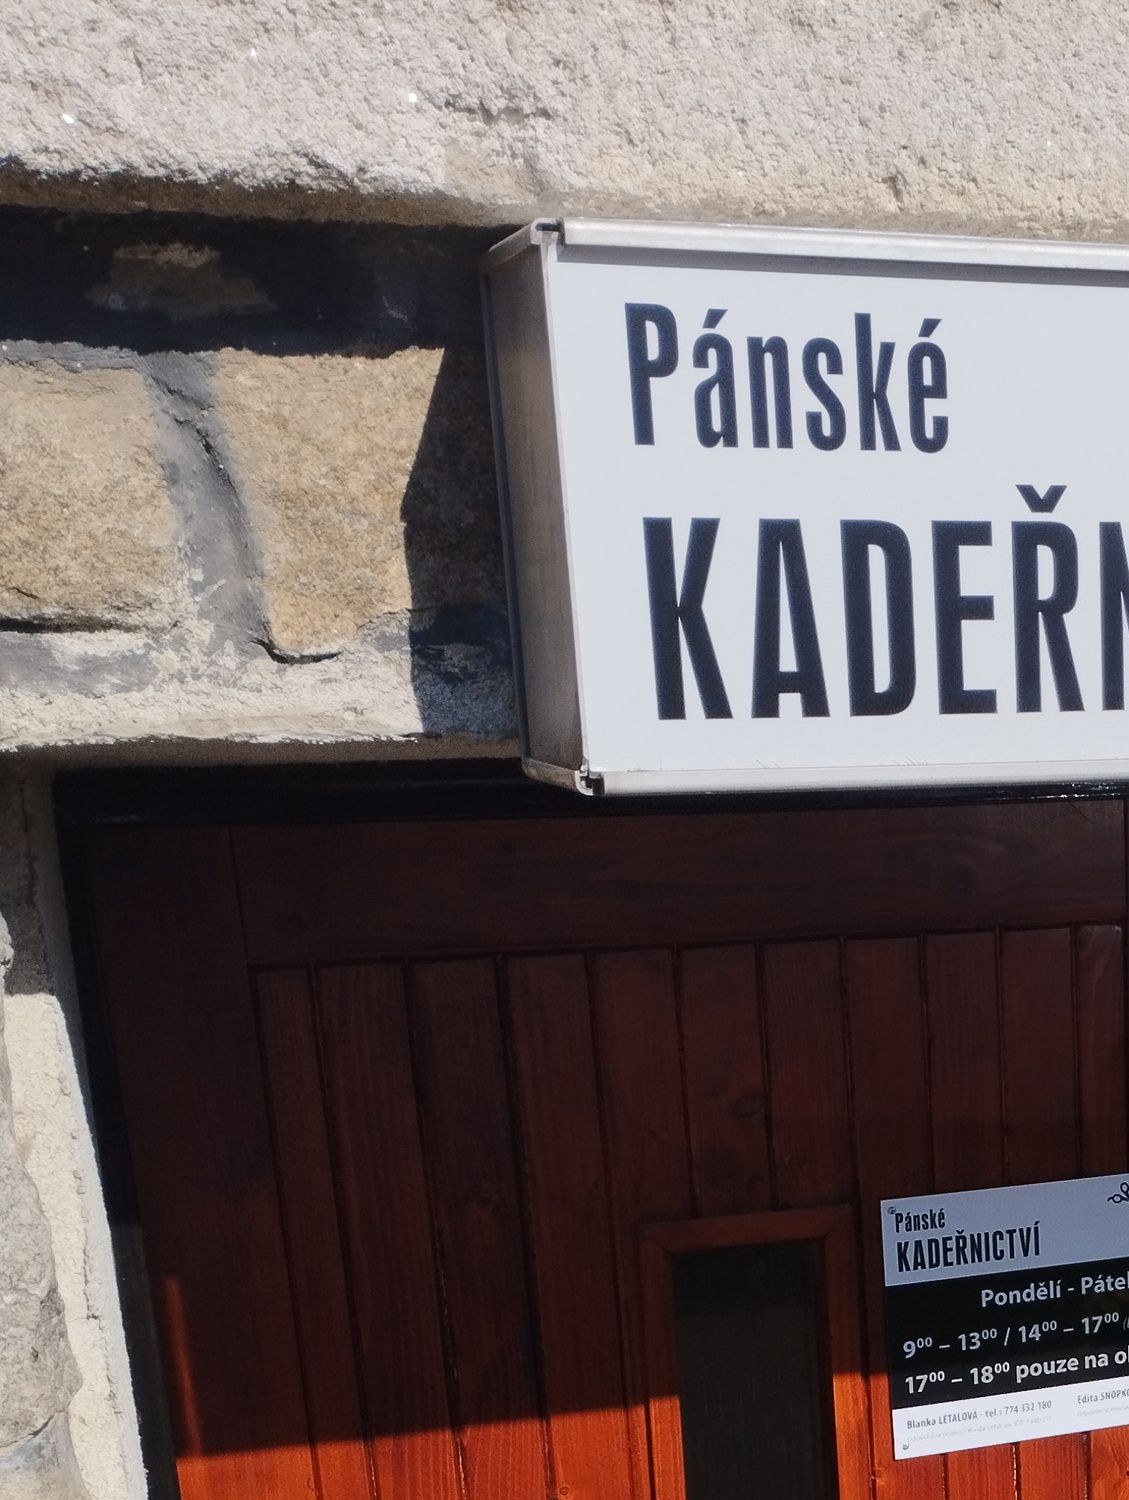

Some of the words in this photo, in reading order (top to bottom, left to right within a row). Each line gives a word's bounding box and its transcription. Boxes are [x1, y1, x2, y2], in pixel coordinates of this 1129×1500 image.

[624, 302, 949, 454] Pánské
[895, 1208, 946, 1234] Pánské
[896, 1220, 1041, 1273] KADEŘNICTVÍ
[981, 1279, 1062, 1308] Pondělí
[1003, 1327, 1011, 1347] /
[1016, 1355, 1079, 1384] pouze
[1084, 1352, 1109, 1369] na
[1077, 1394, 1099, 1404] Edita
[907, 1417, 936, 1429] Blanka
[939, 1409, 978, 1425] LÉTALOVÁ
[1004, 1405, 1019, 1416] 774
